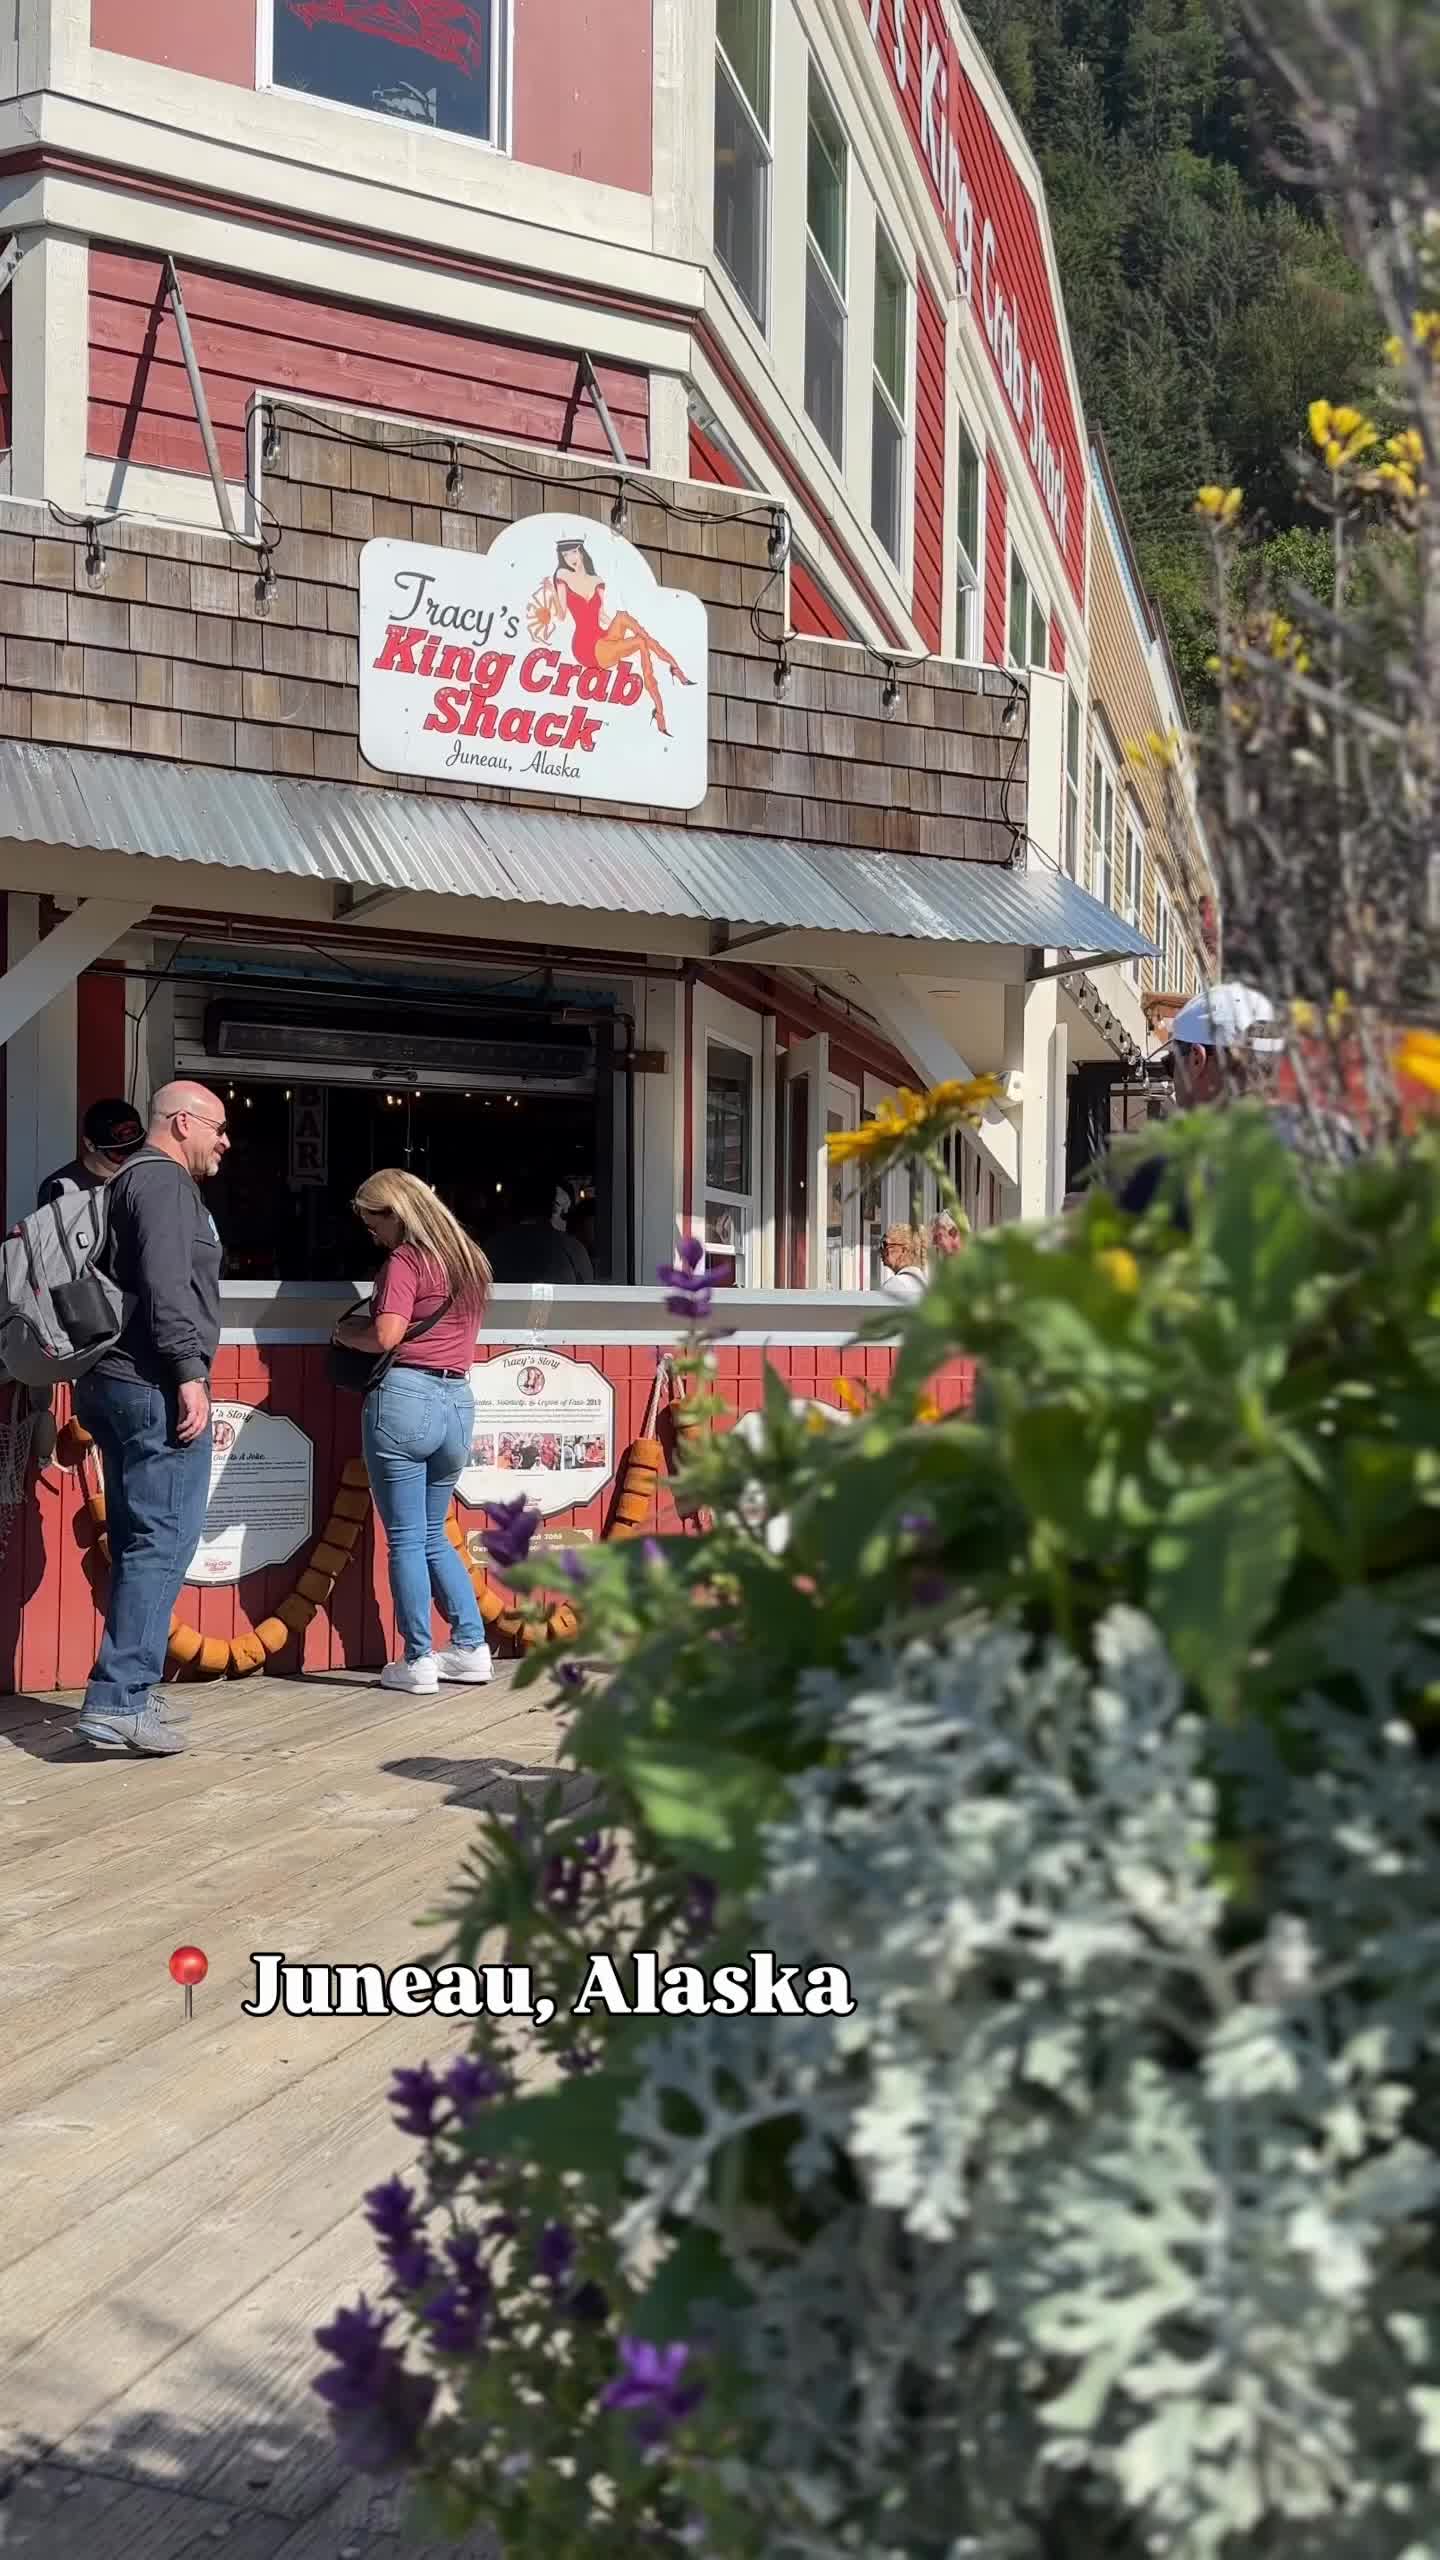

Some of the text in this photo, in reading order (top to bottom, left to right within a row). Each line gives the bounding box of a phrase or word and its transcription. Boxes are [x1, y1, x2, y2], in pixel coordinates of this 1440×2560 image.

[921, 8, 1067, 546] King Crab Shack
[389, 571, 520, 647] Tracy's
[373, 624, 644, 706] King Crab
[423, 685, 603, 753] Shack
[445, 740, 581, 779] Juneau, Alaska
[502, 1355, 561, 1369] Tracy's Story
[226, 1408, 254, 1423] Story
